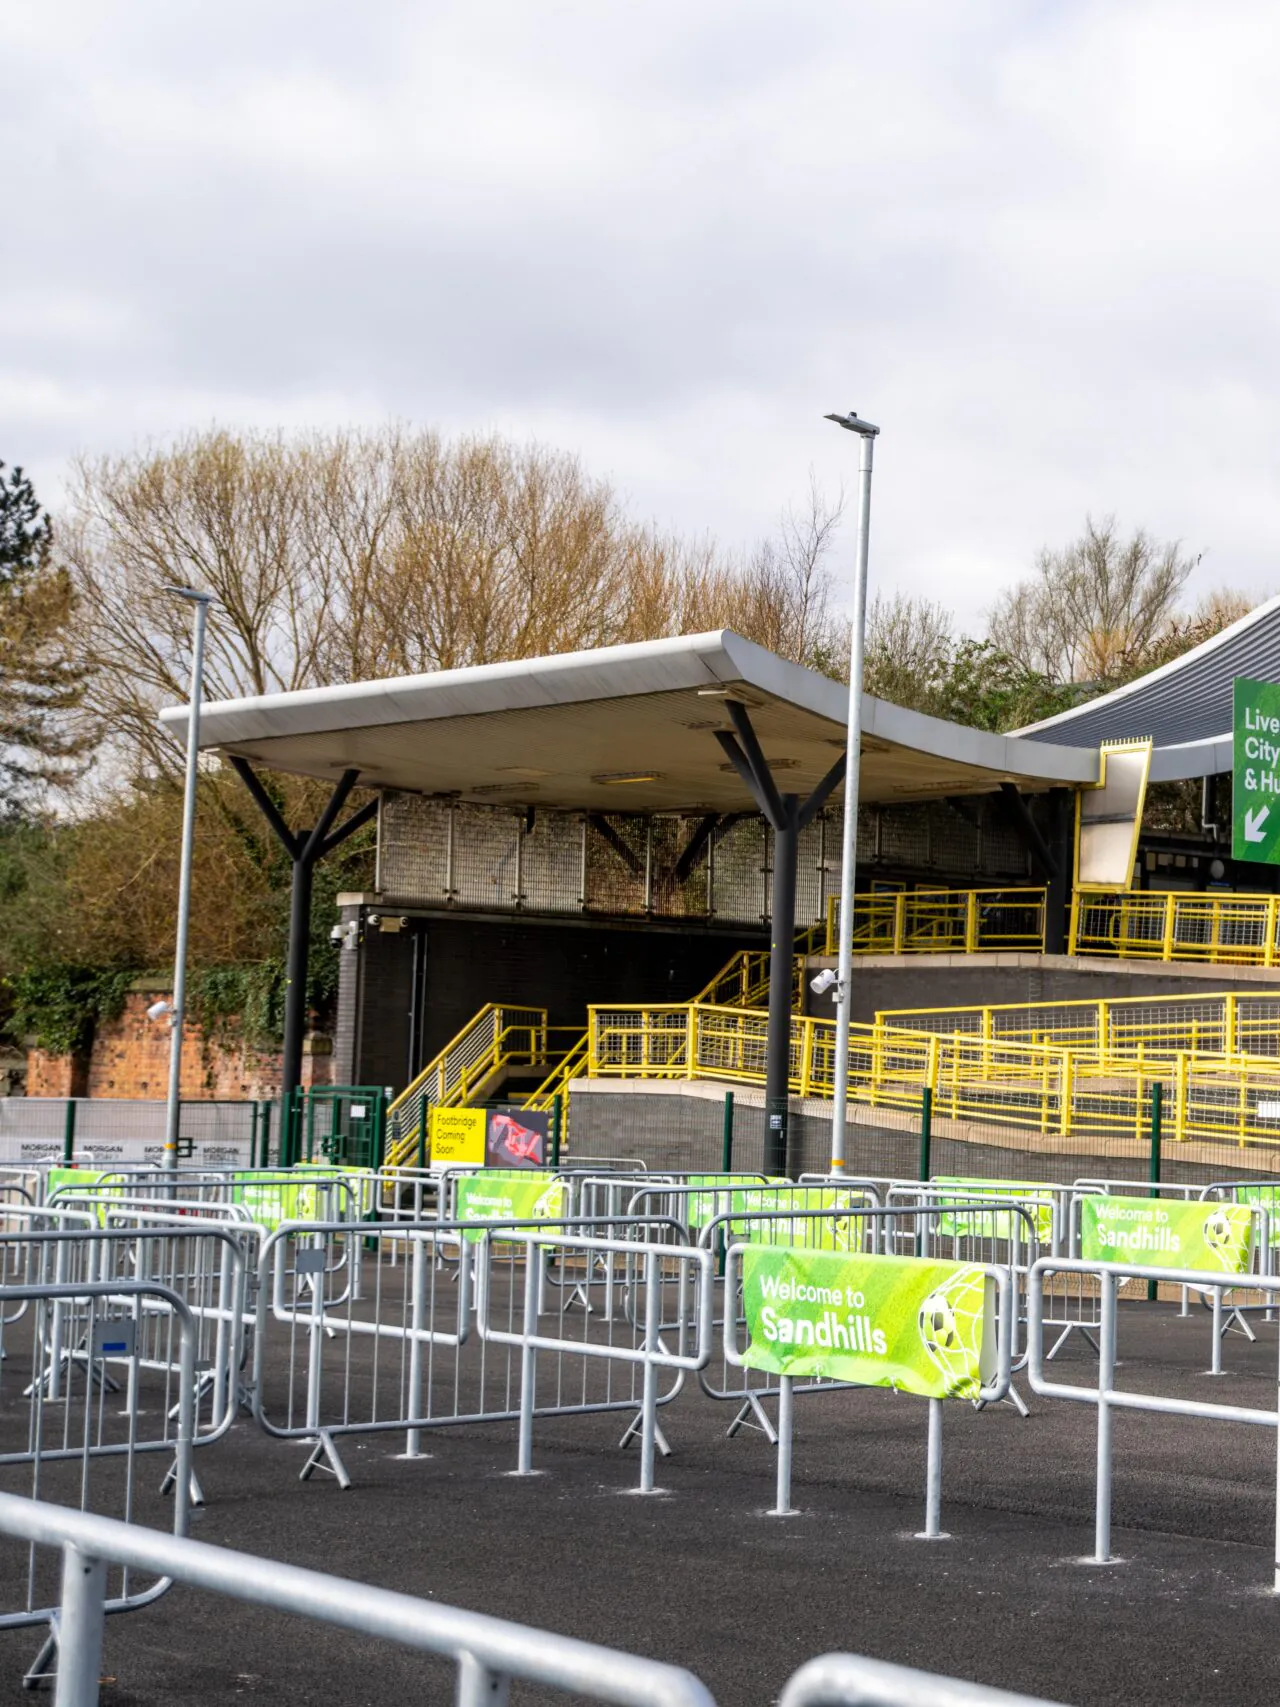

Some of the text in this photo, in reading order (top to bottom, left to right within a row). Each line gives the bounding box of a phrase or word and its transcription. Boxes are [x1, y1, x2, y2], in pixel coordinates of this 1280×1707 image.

[1245, 737, 1280, 769] City
[1245, 768, 1257, 790] &
[437, 1114, 477, 1130] Footbridge
[436, 1129, 466, 1144] Coming
[83, 1145, 123, 1153] MORGAN
[436, 1144, 454, 1154] Soon
[1096, 1203, 1168, 1223] Welcome to
[1097, 1223, 1181, 1252] Sandhills
[759, 1275, 865, 1309] Welcome to
[761, 1307, 887, 1355] Sandhills
